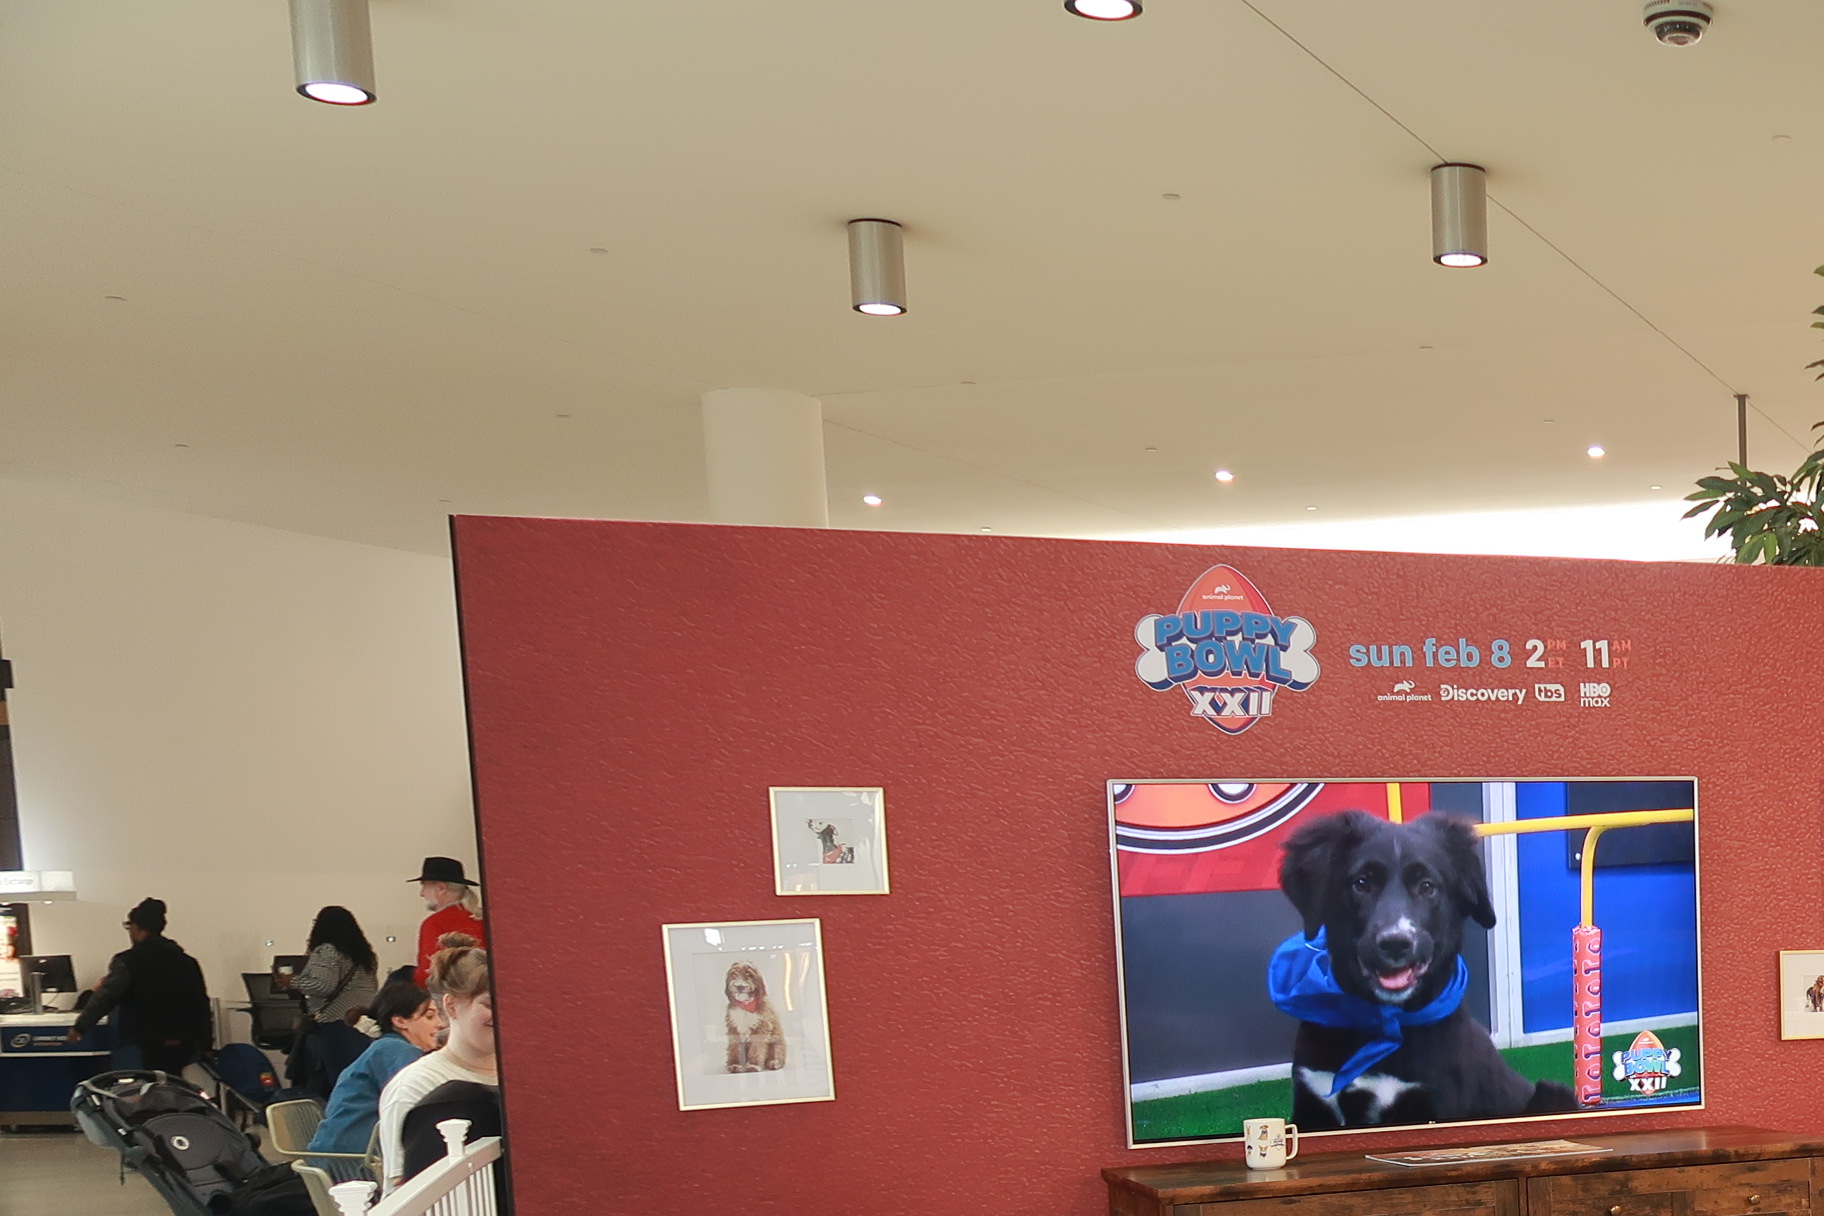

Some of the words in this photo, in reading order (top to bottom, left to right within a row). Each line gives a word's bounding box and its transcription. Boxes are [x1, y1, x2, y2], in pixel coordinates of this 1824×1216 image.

[1224, 593, 1244, 601] planet
[1155, 610, 1298, 651] PUPPY
[1349, 642, 1413, 668] sun
[1423, 637, 1480, 668] feb
[1490, 639, 1512, 668] 8
[1524, 638, 1546, 668] 2
[1547, 639, 1567, 651] PM
[1612, 639, 1632, 652] AM
[1580, 639, 1610, 668] 11
[1165, 639, 1294, 684] BOWL
[1548, 657, 1565, 668] ET
[1612, 657, 1629, 668] PT
[1439, 684, 1527, 705] Discovery
[1537, 686, 1562, 699] tbs
[1580, 682, 1612, 697] HBO
[1189, 686, 1272, 717] XXII
[1377, 693, 1405, 702] animal
[1406, 693, 1432, 703] planet
[1580, 697, 1611, 707] max
[1621, 1047, 1672, 1064] PUPPY
[1625, 1060, 1670, 1076] BOWL
[1628, 1076, 1668, 1091] XXII
